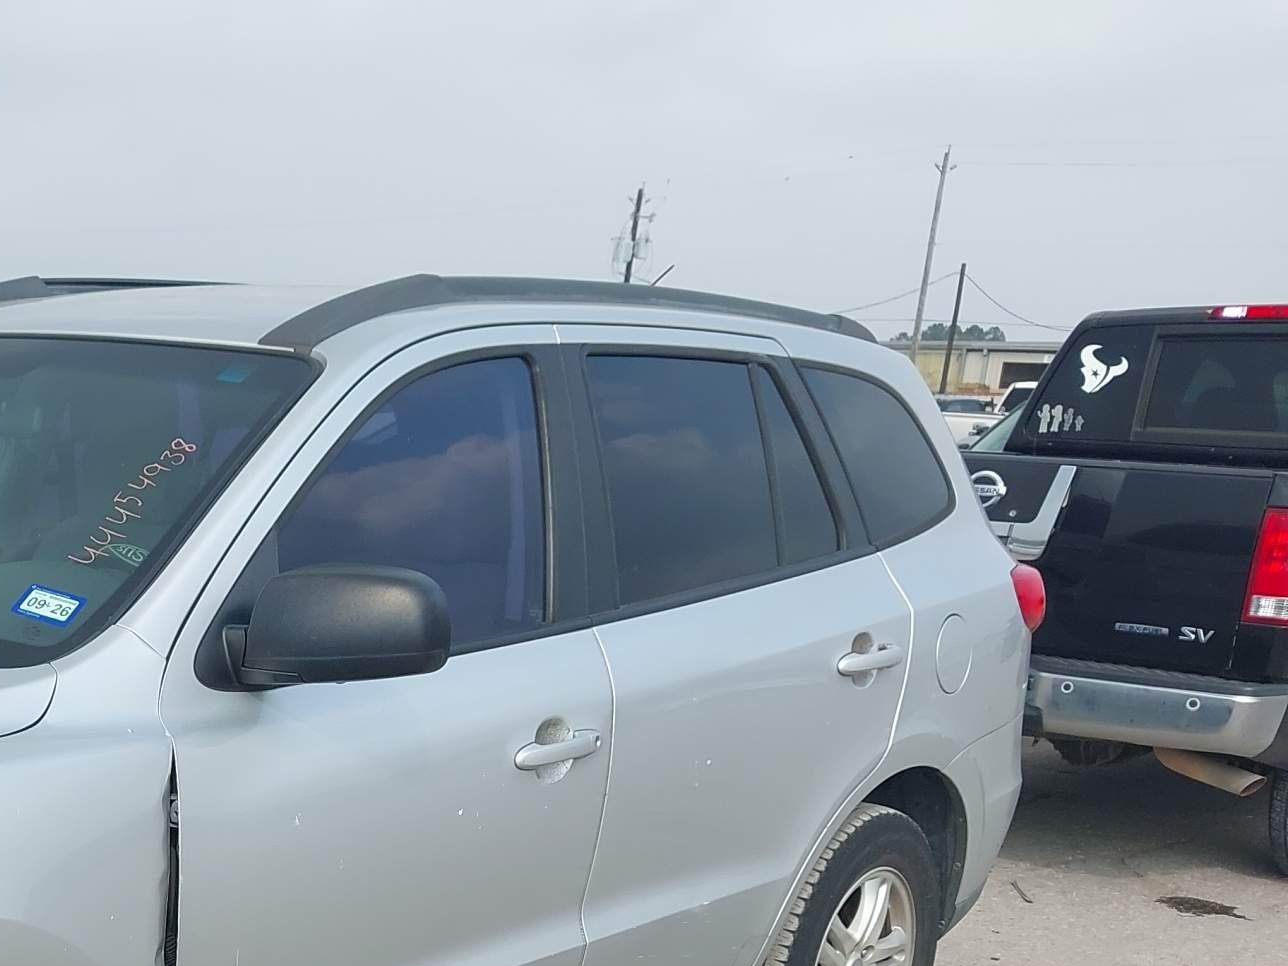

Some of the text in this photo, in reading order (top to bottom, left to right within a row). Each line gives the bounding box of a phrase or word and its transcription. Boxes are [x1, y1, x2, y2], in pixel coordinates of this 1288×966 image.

[67, 438, 198, 566] 44454938
[26, 596, 47, 610] 09
[50, 603, 72, 617] 26
[1178, 626, 1215, 644] SV
